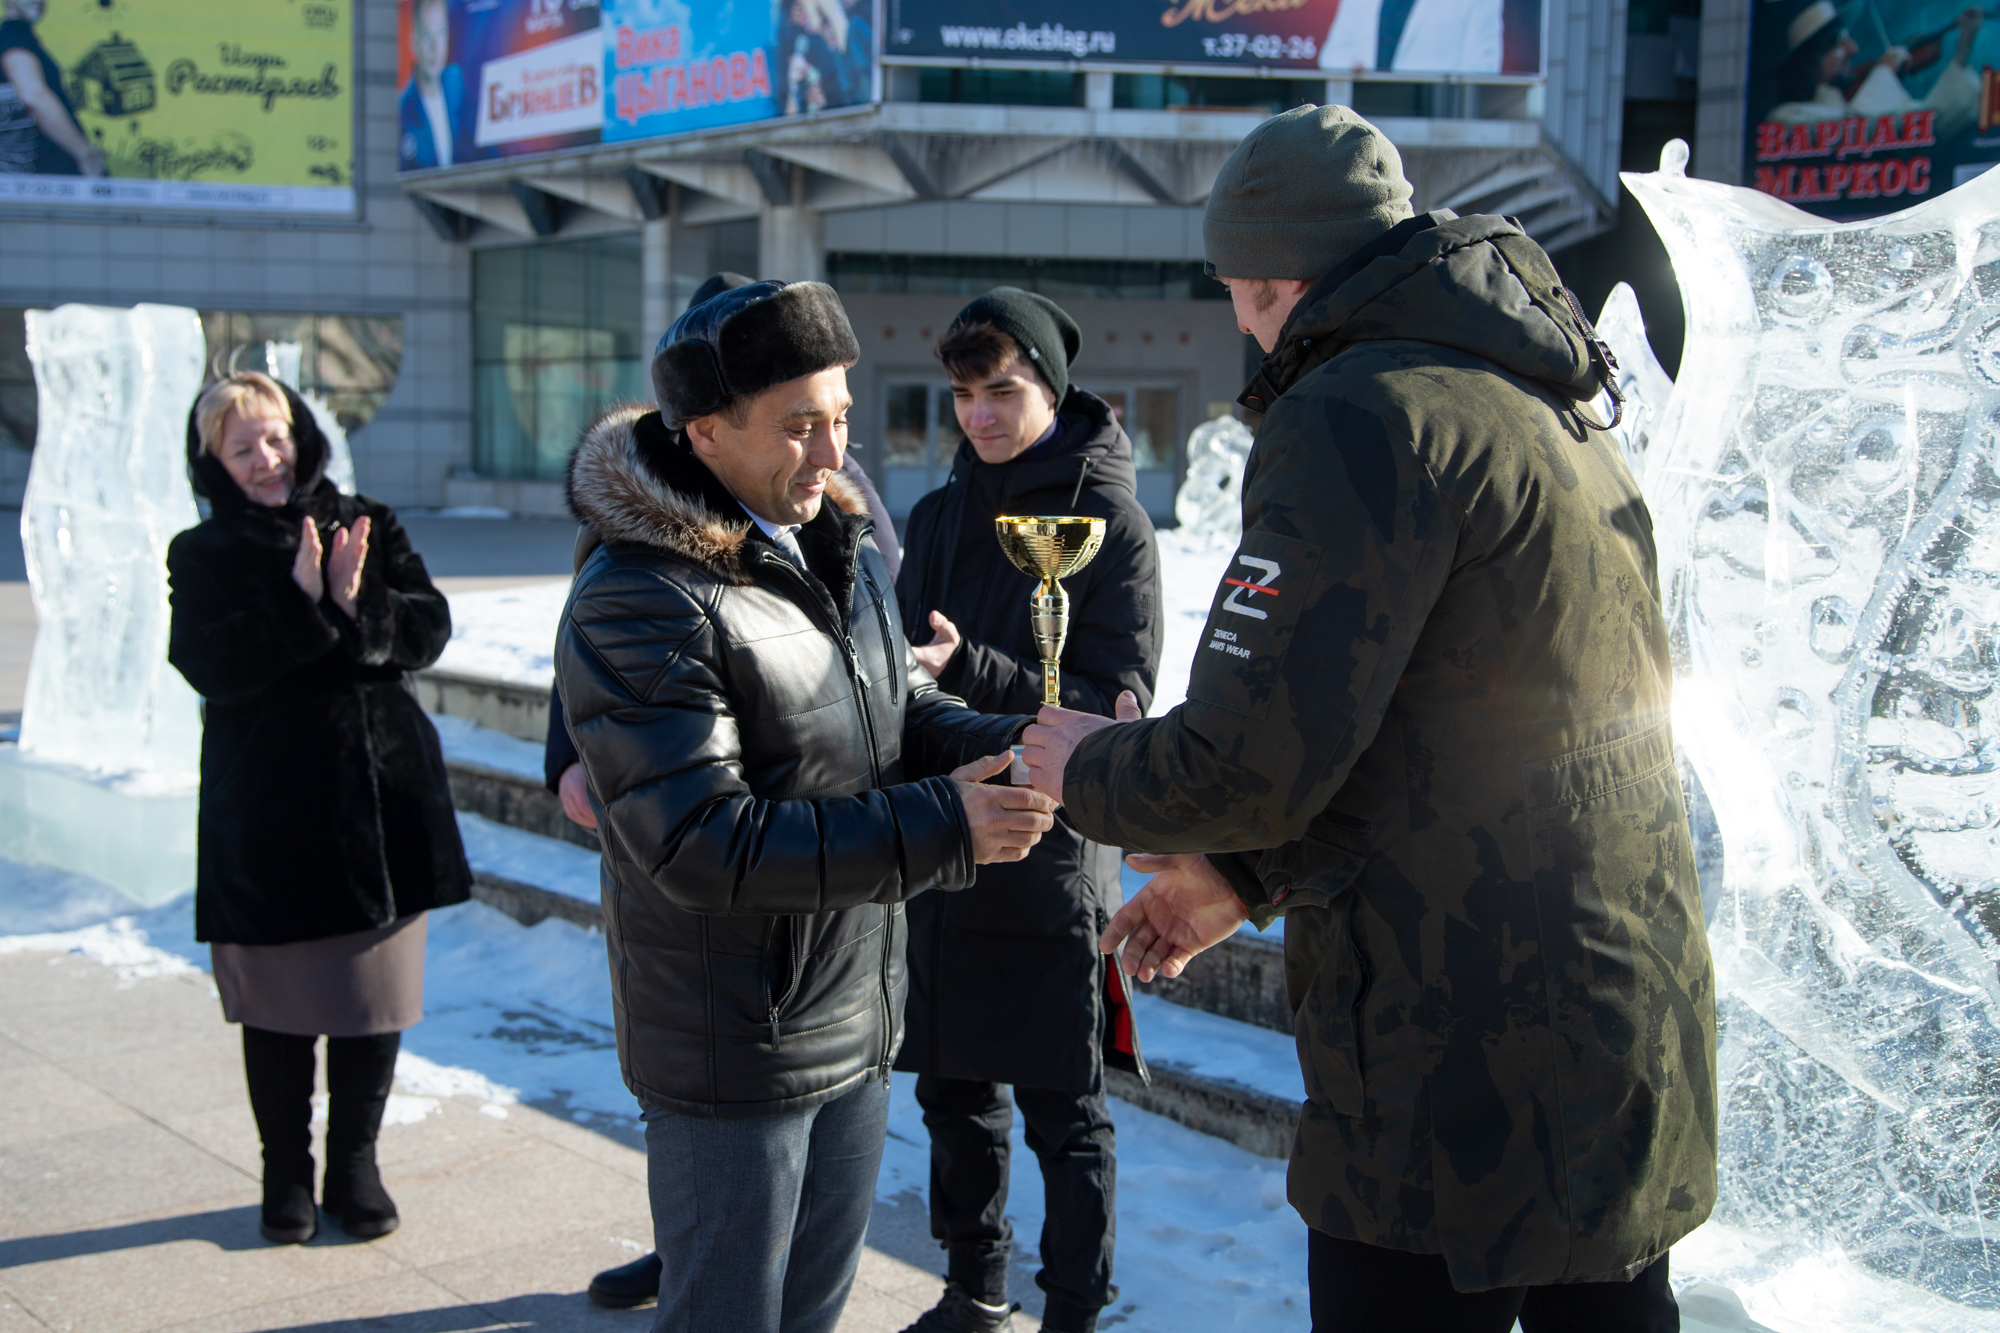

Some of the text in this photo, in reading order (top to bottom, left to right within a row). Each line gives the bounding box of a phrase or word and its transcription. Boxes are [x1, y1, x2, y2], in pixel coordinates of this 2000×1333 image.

[616, 26, 681, 69] Вика
[940, 21, 1116, 57] www.okcblag.ru
[616, 48, 772, 126] ЦЫГАНОВА
[1755, 110, 1936, 161] ВАРДАН
[1755, 156, 1932, 203] МАРКОС
[1213, 628, 1238, 643] ZENECA
[1226, 644, 1251, 659] WEAR
